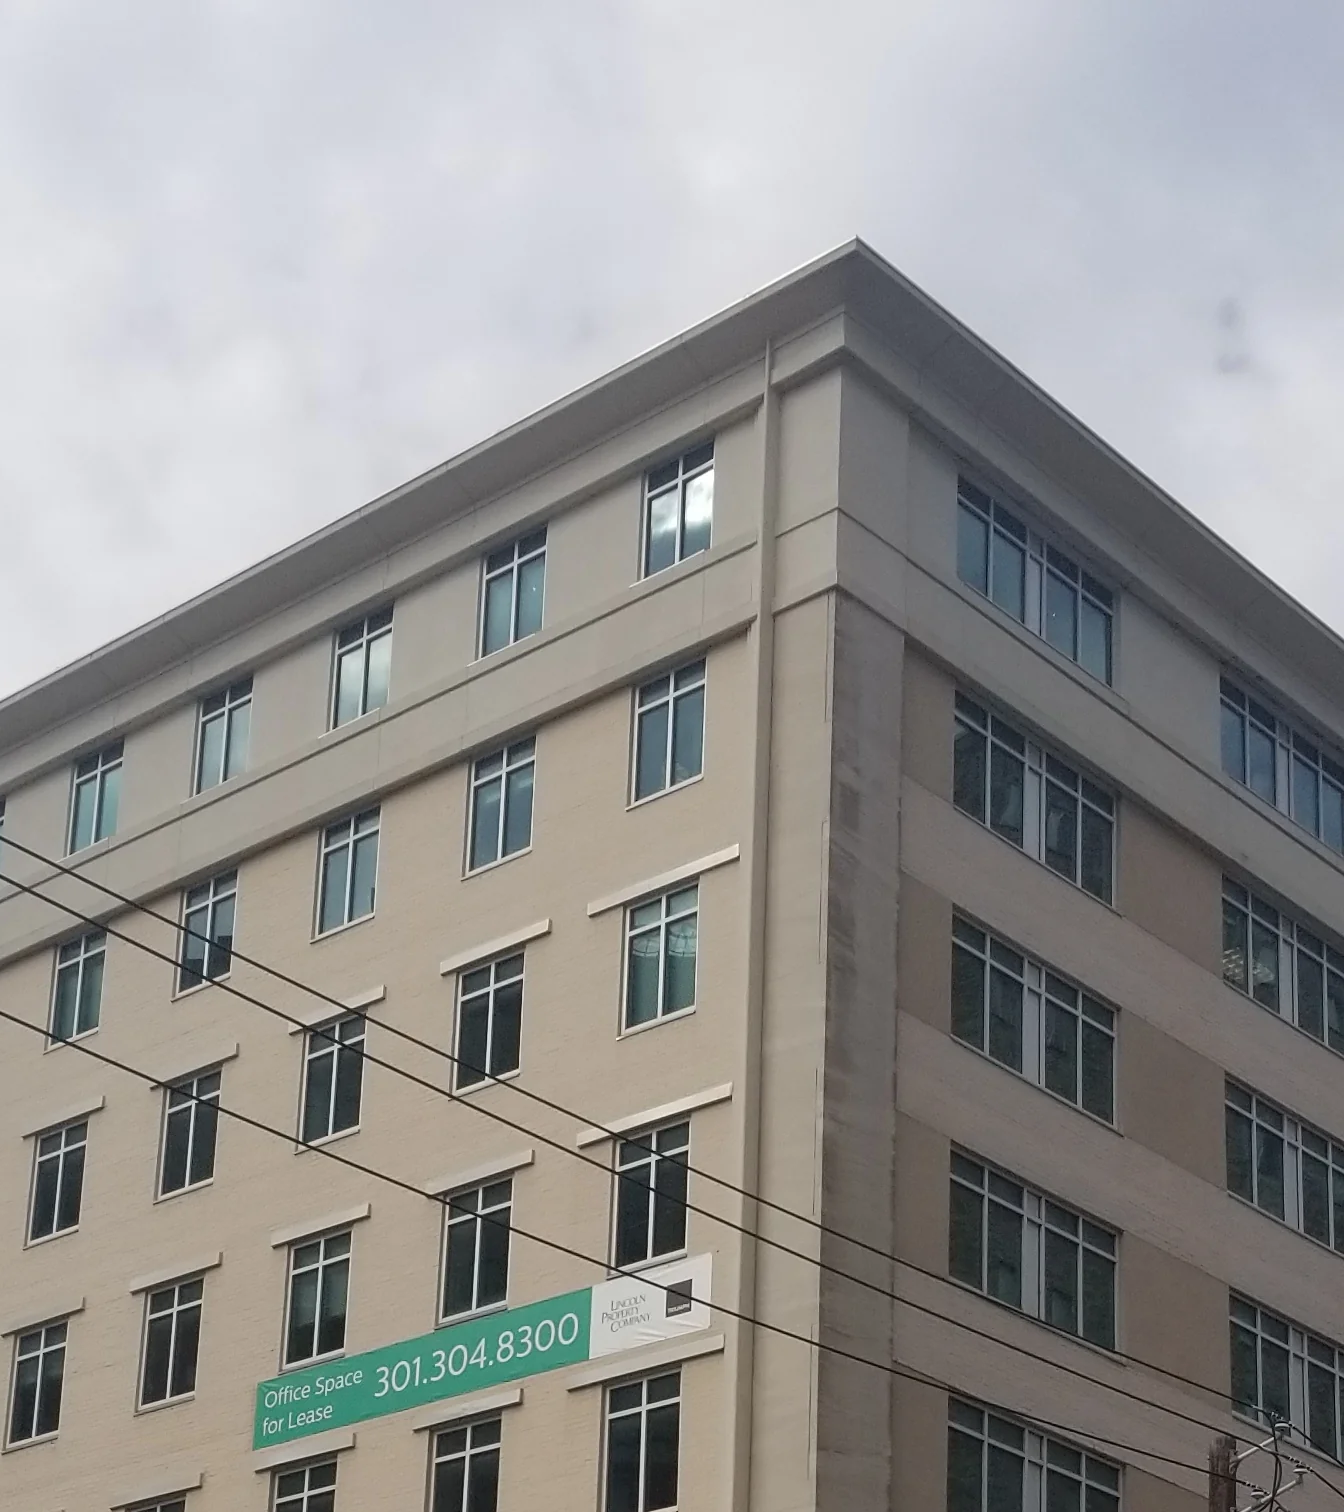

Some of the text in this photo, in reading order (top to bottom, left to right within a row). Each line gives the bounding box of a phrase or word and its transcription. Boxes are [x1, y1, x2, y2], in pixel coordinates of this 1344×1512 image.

[611, 1294, 646, 1311] LINCOLN
[602, 1307, 639, 1324] PROPERTY
[611, 1313, 650, 1332] COMPANY
[374, 1313, 579, 1397] 301.304.8300
[264, 1370, 363, 1408] Office Space
[263, 1405, 333, 1436] for Lease
